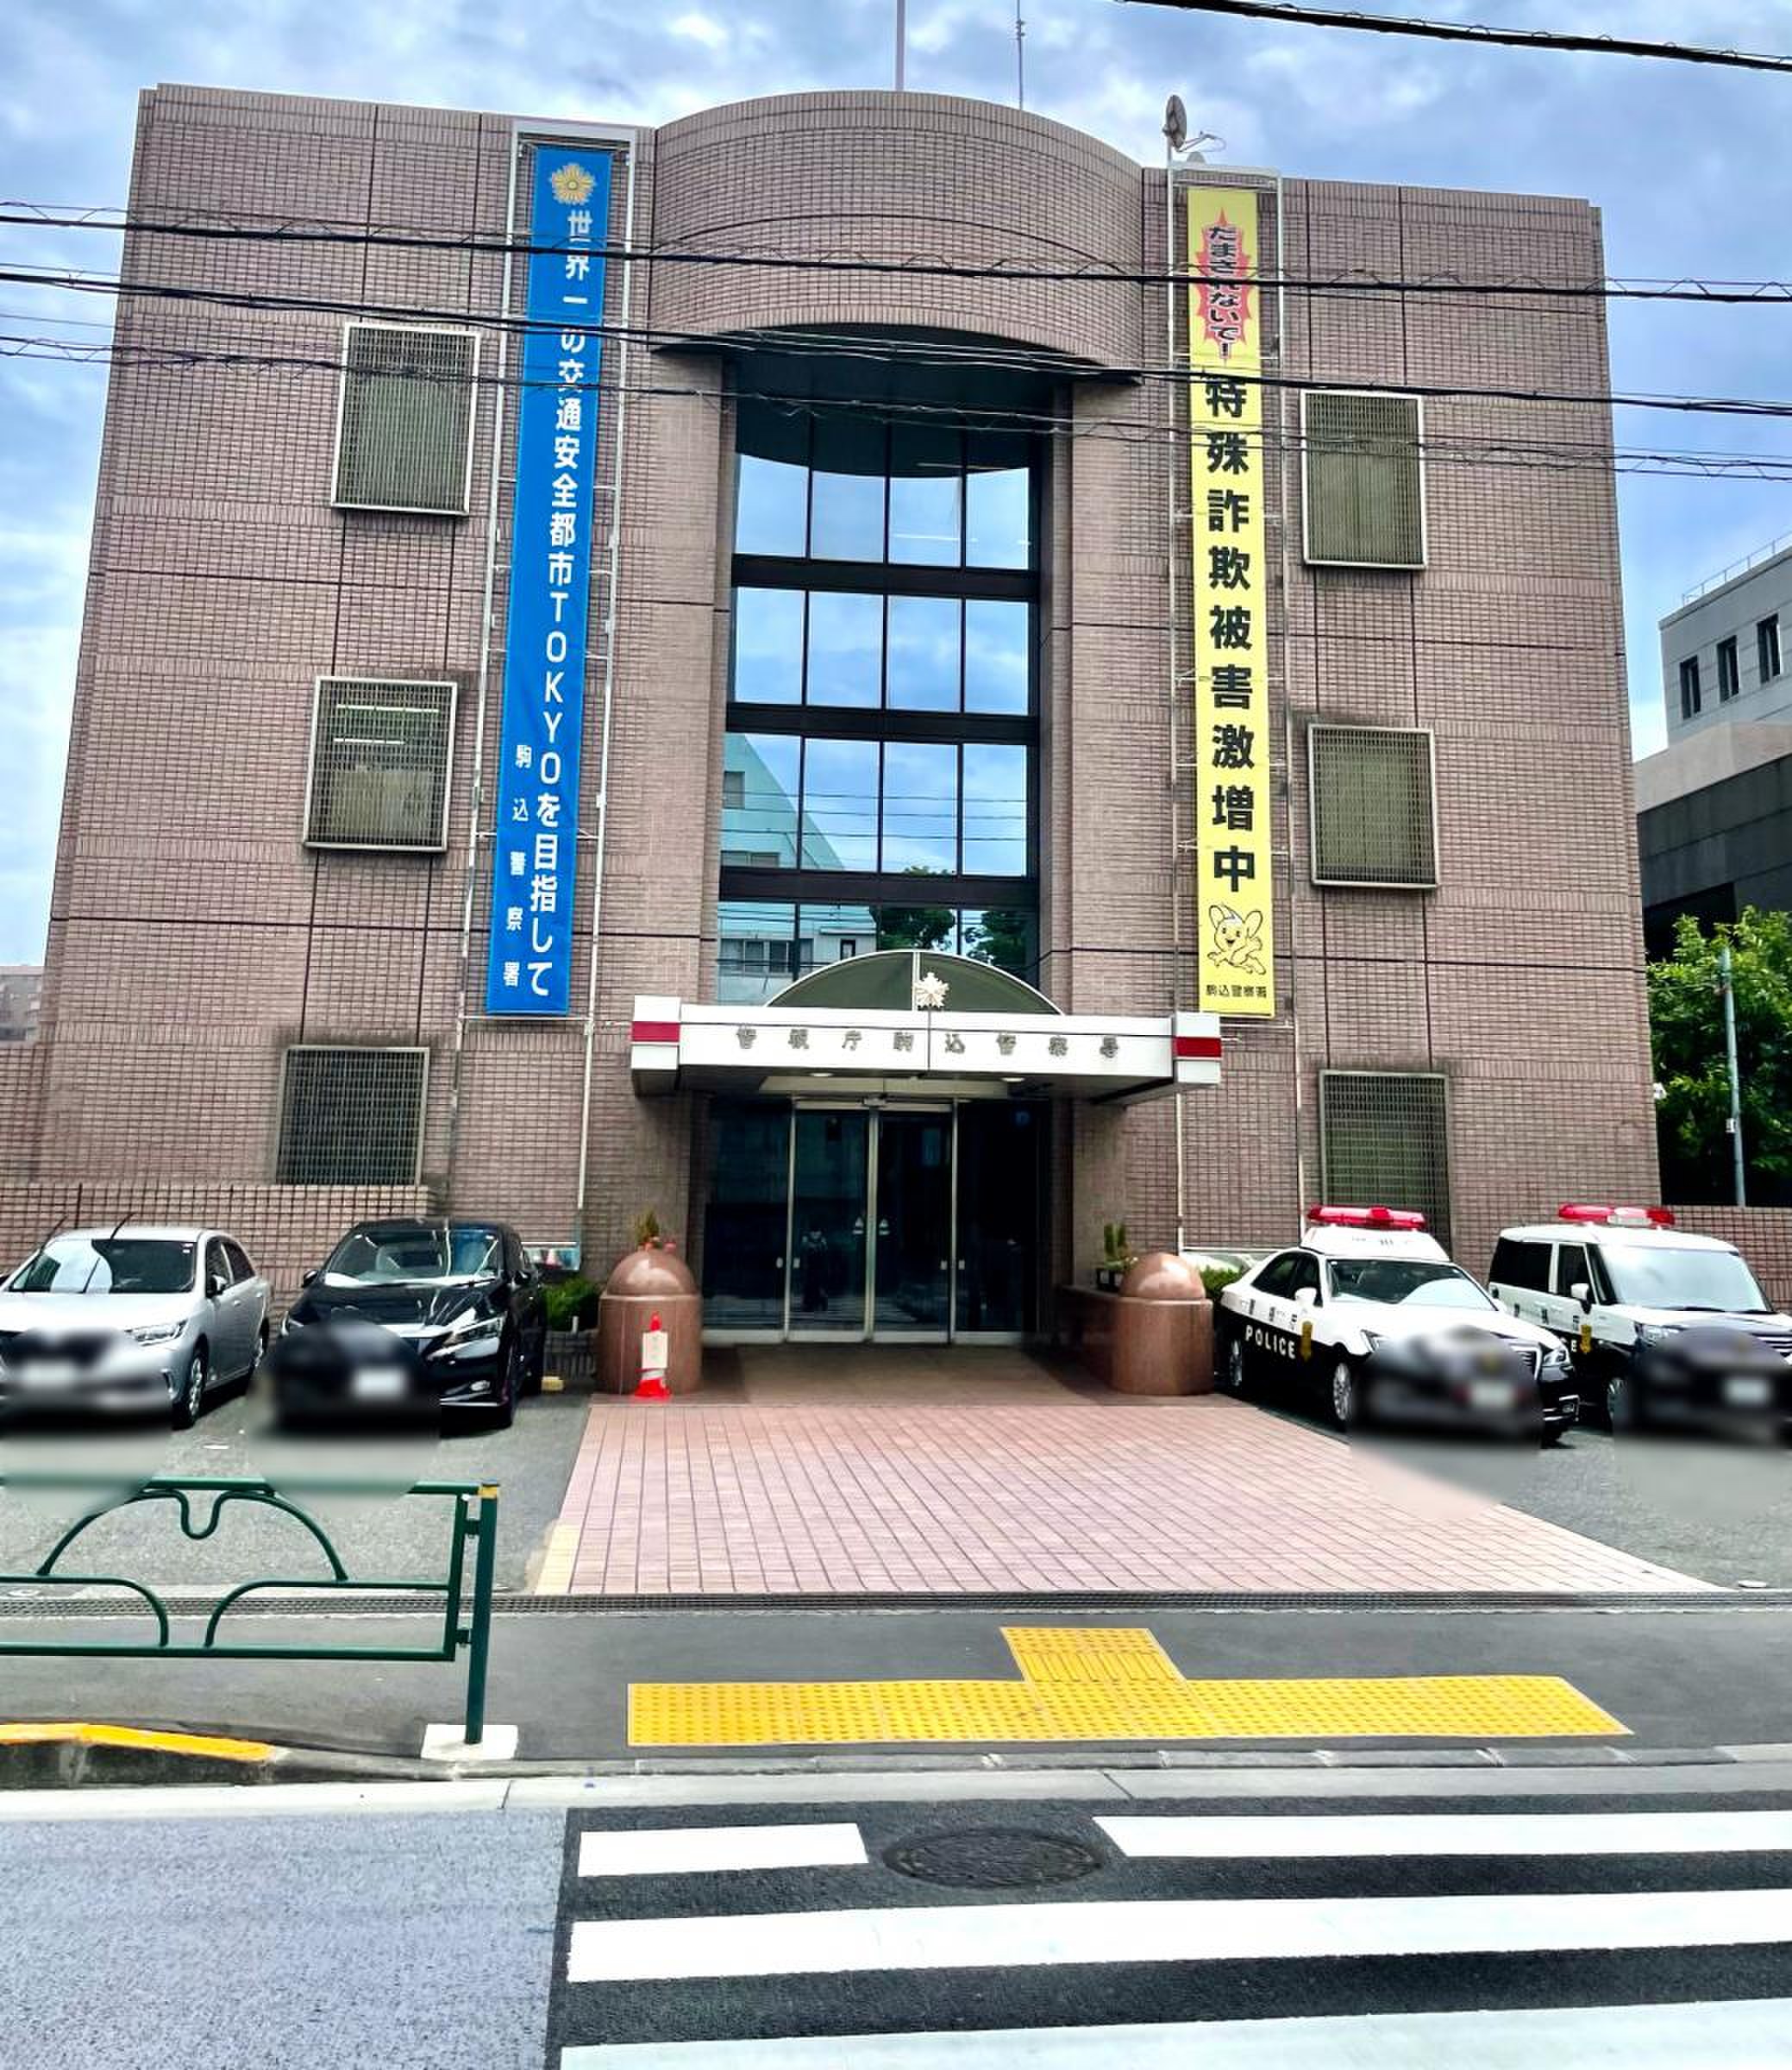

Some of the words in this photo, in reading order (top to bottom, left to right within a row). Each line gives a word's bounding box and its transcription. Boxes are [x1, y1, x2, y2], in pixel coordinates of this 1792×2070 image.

[1205, 375, 1256, 893] 特殊詐欺被害激増中
[503, 744, 532, 987] 駒込警察署
[1244, 1325, 1296, 1359] POLICE
